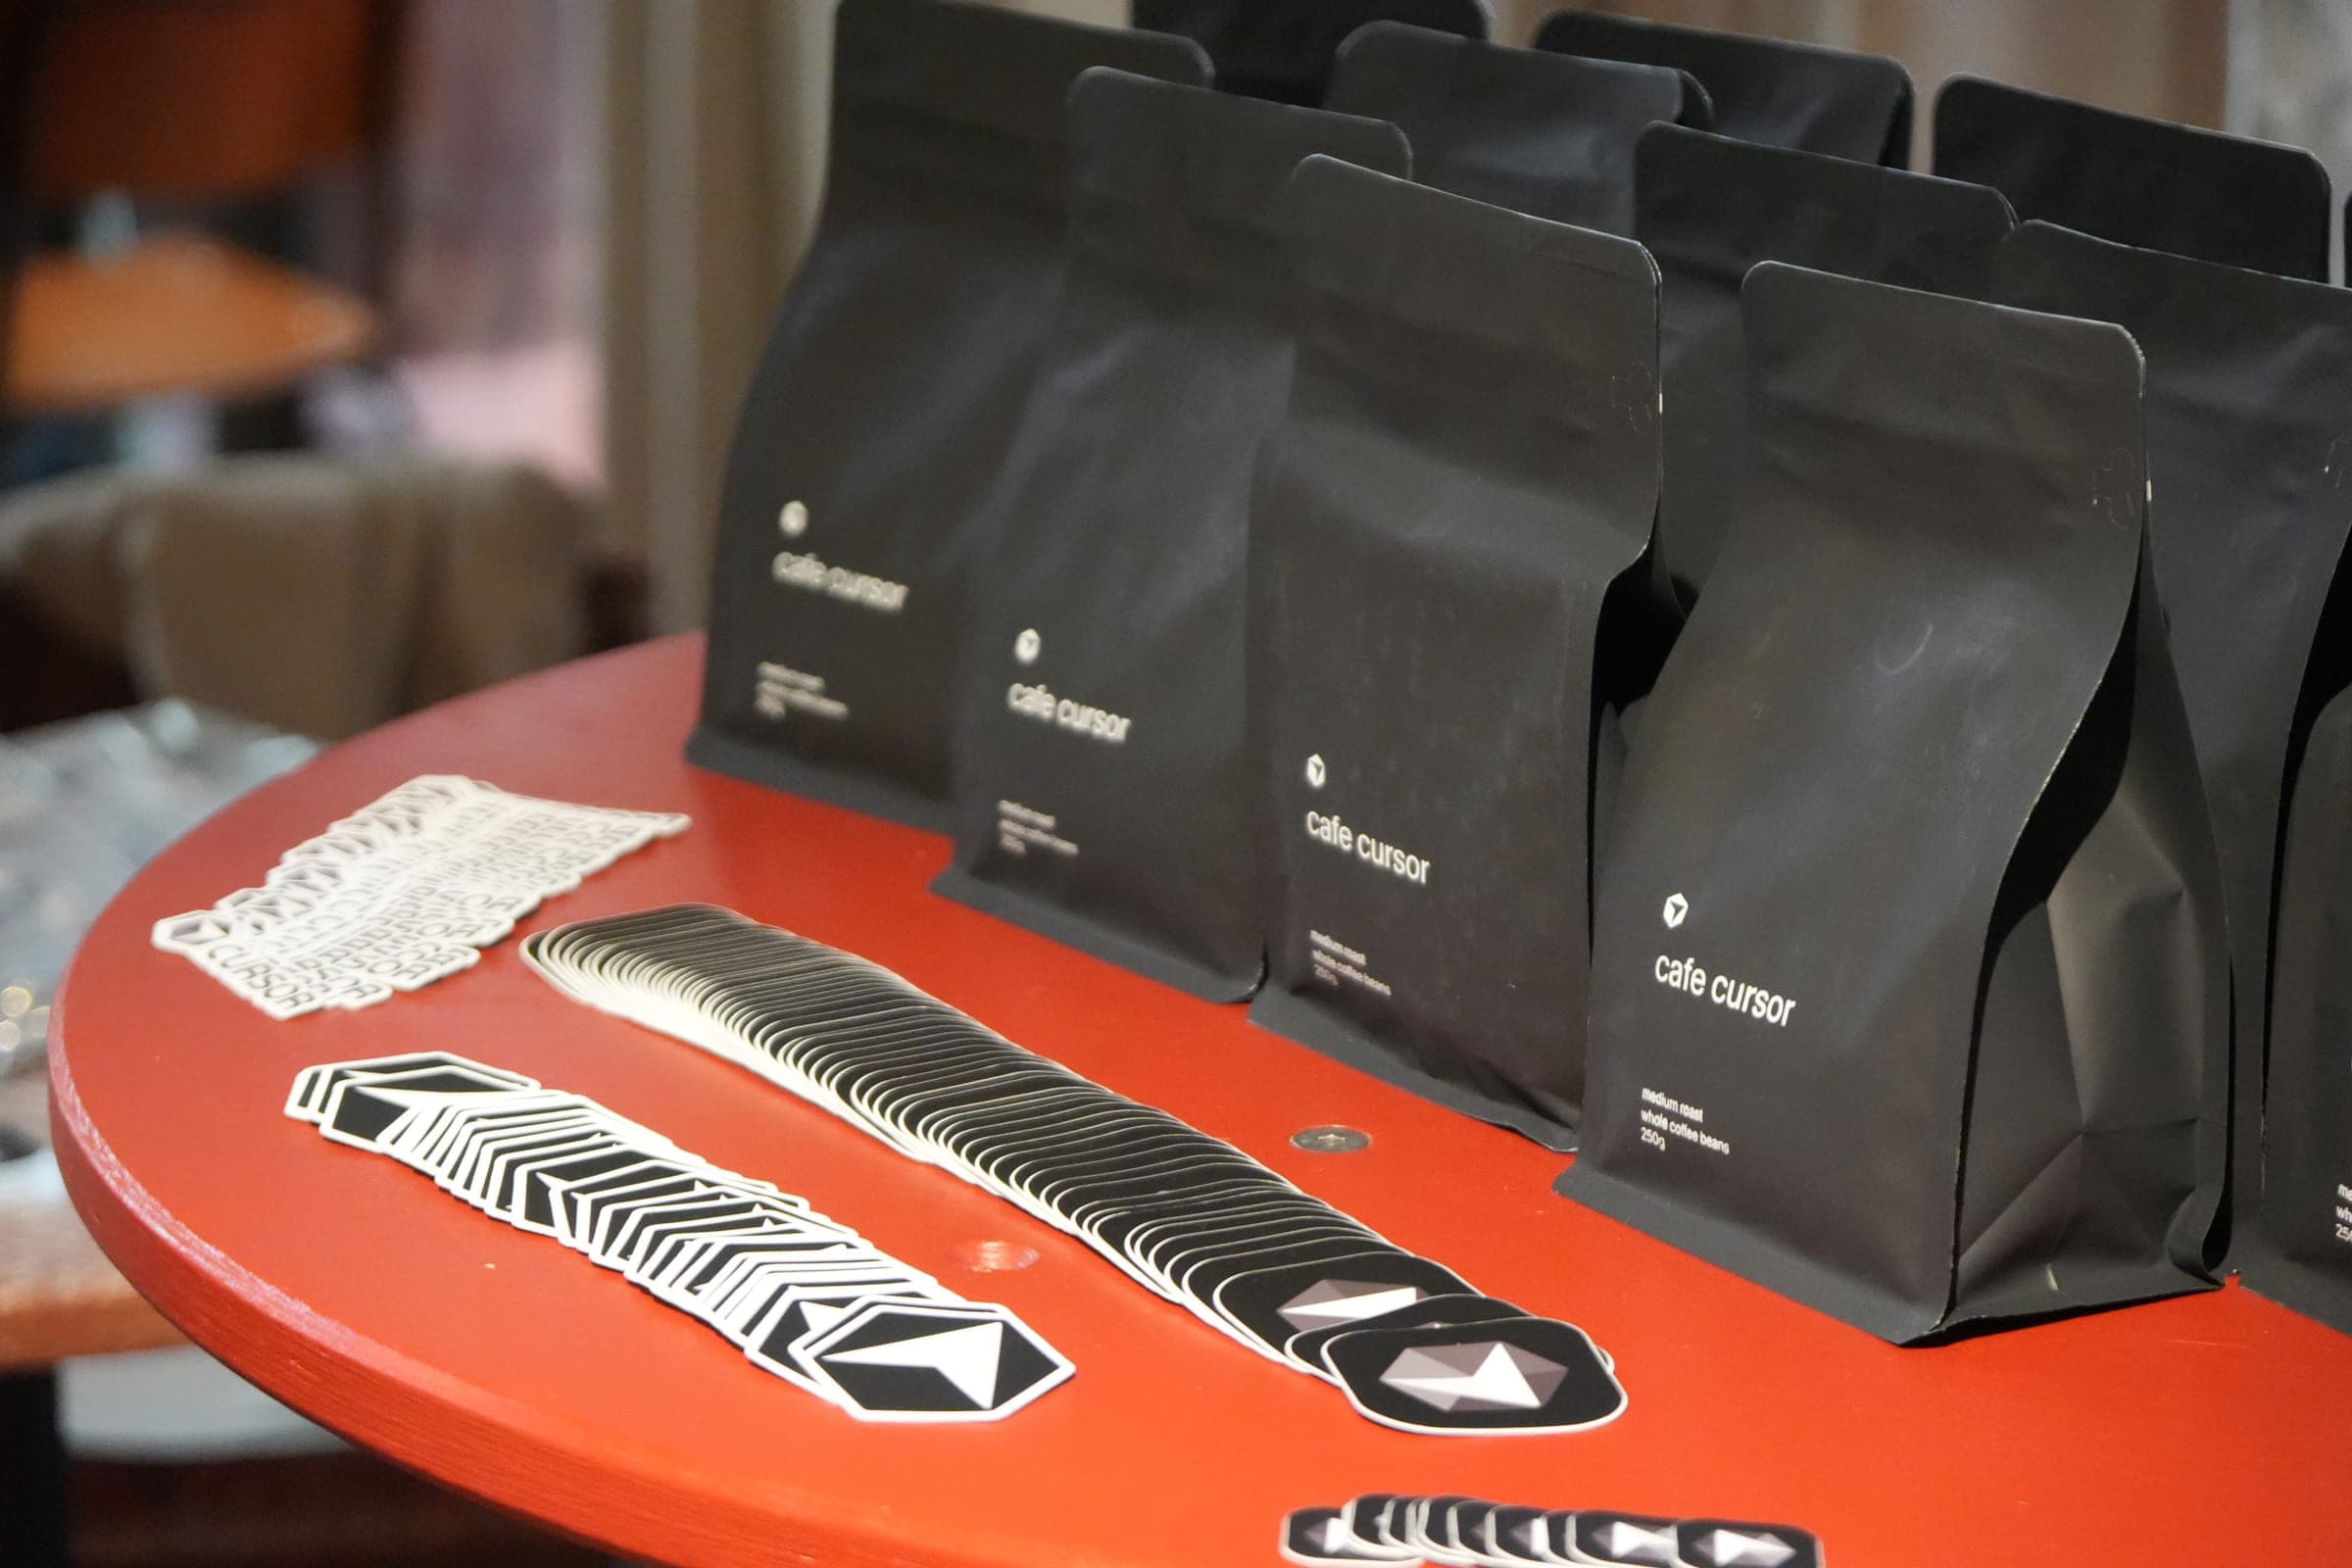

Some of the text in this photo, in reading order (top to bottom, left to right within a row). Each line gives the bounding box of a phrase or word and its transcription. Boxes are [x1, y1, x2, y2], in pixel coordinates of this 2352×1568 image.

[1056, 699, 1131, 742] cursor
[1306, 810, 1430, 884] cafe cursor
[208, 944, 315, 1008] CURSOR
[1655, 955, 1796, 1027] cafe cursor
[1642, 1088, 1703, 1123] medium roast
[1641, 1109, 1730, 1154] whole coffee beans
[1641, 1126, 1666, 1152] 250g
